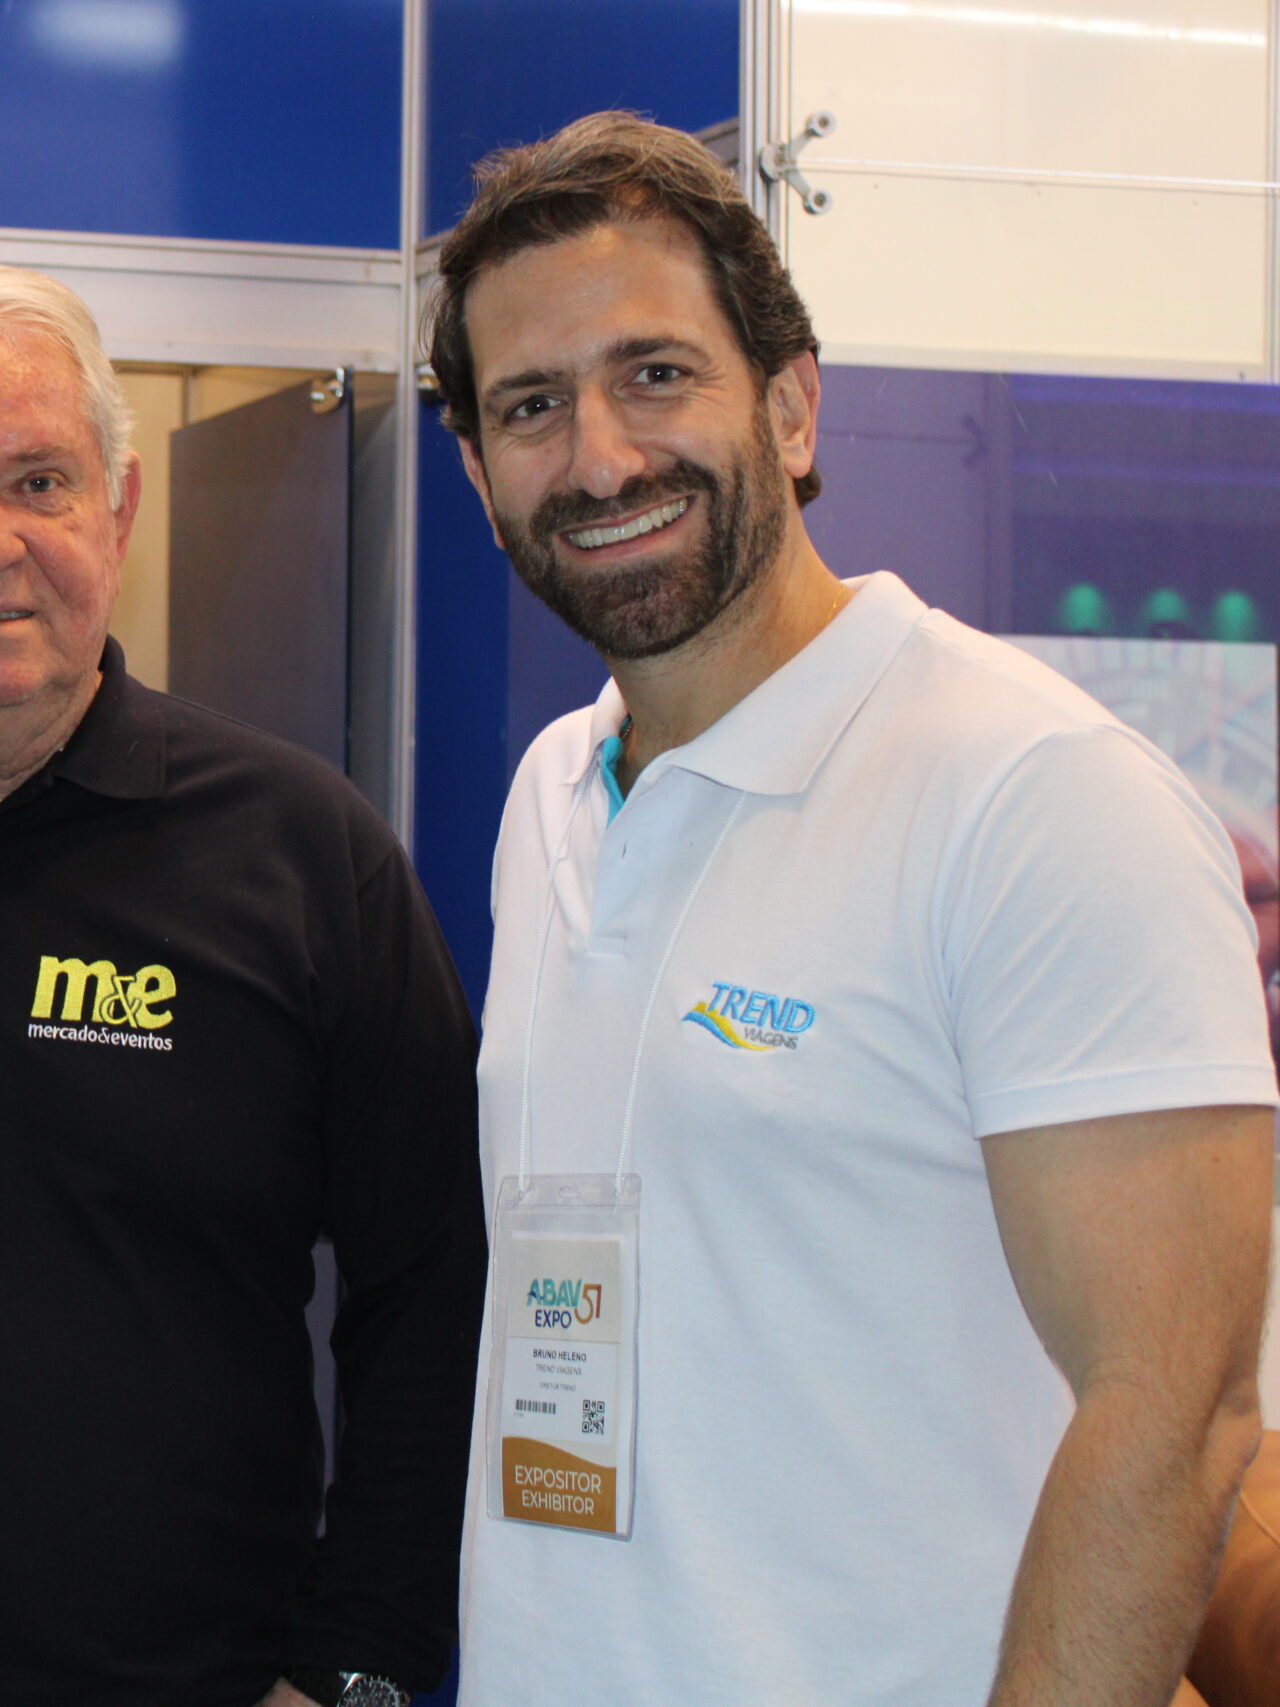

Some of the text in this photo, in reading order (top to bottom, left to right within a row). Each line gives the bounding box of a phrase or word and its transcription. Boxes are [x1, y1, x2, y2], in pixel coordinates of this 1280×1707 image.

[30, 955, 177, 1030] m&e
[706, 981, 815, 1033] TREND
[28, 1023, 173, 1050] mercado&eventos
[744, 1026, 798, 1049] VIAGENS
[526, 1278, 602, 1325] ABAV 51
[534, 1309, 572, 1330] EXPO
[532, 1348, 587, 1362] BRUNO HELENO
[536, 1363, 555, 1373] TREND
[514, 1464, 602, 1495] EXPOSITOR
[521, 1489, 595, 1516] EXHIBITOR
